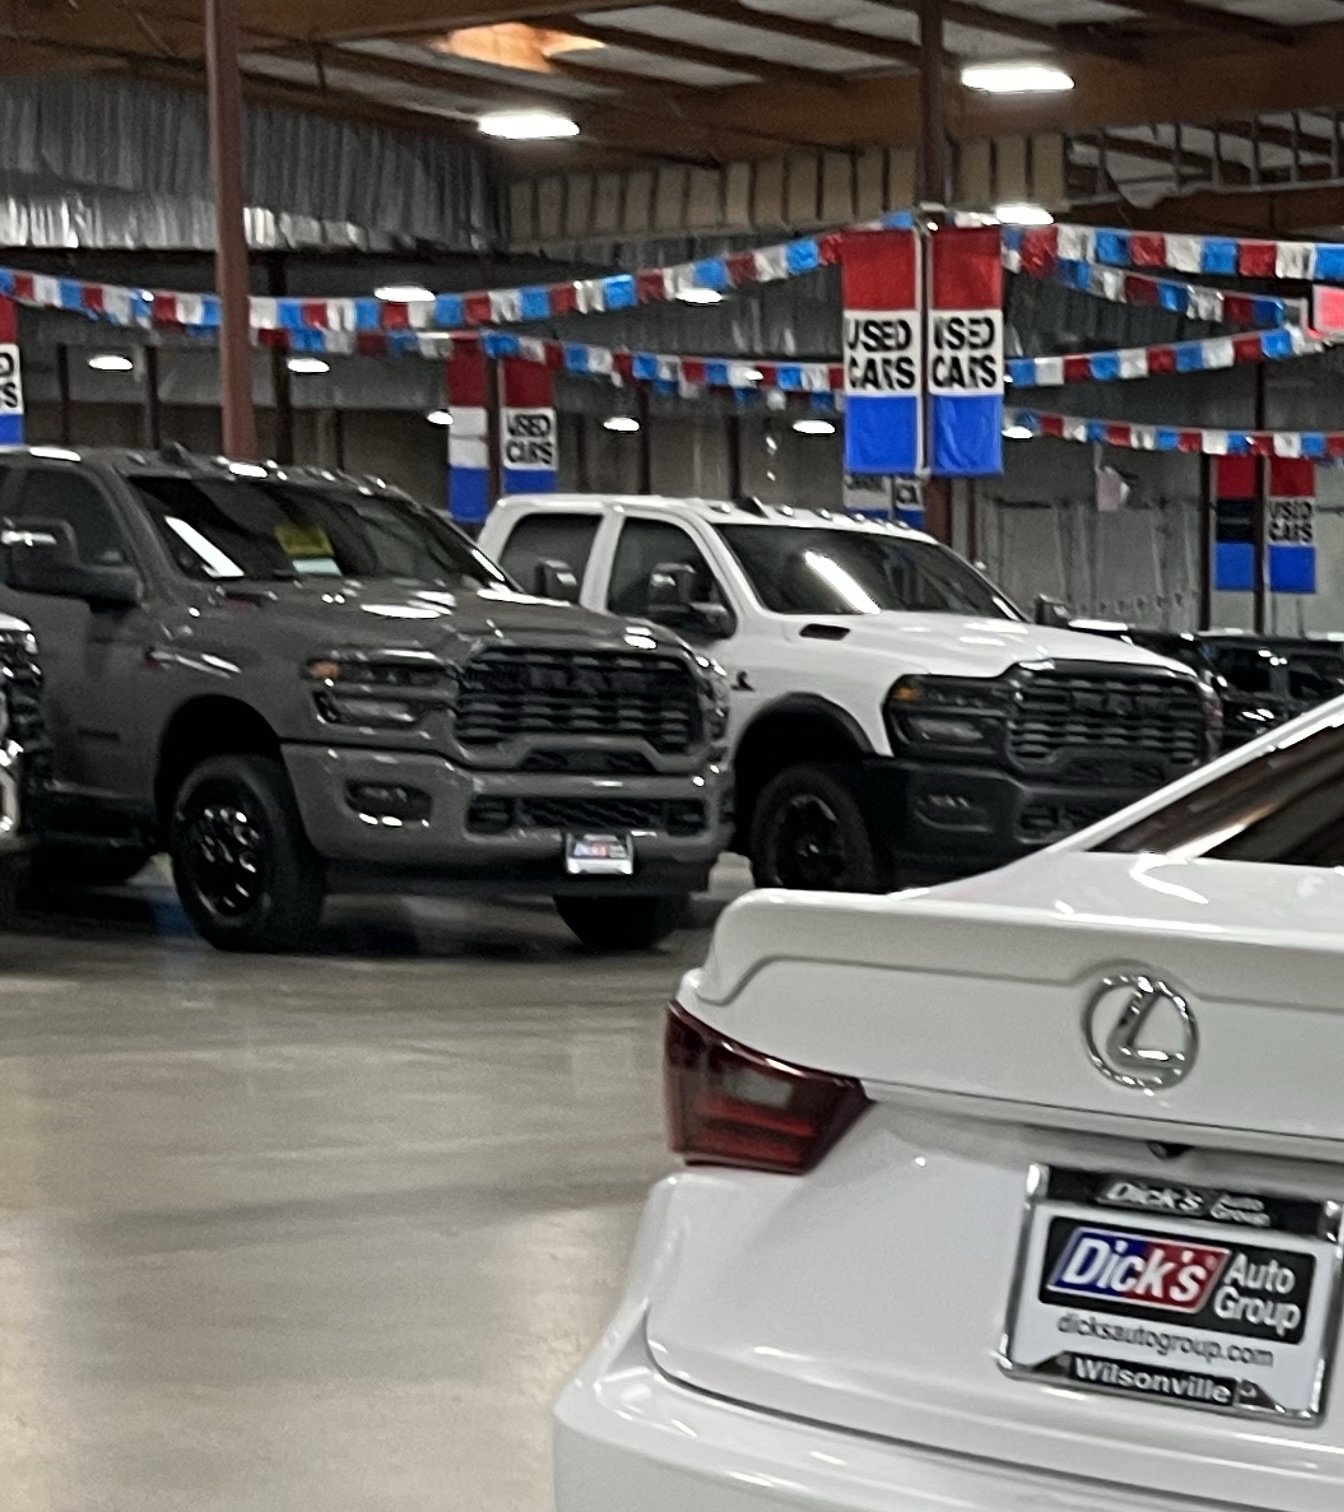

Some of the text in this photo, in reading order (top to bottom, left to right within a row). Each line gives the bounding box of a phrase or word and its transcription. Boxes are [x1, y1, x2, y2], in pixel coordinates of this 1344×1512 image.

[847, 319, 912, 352] USED
[934, 317, 995, 350] USED
[848, 356, 916, 390] CARS
[932, 355, 998, 388] CARS
[1062, 1236, 1296, 1303] Dick's Auto
[1213, 1286, 1302, 1336] Group
[1056, 1313, 1274, 1367] dicksautogroup.com
[1074, 1356, 1233, 1404] Wilsonville
